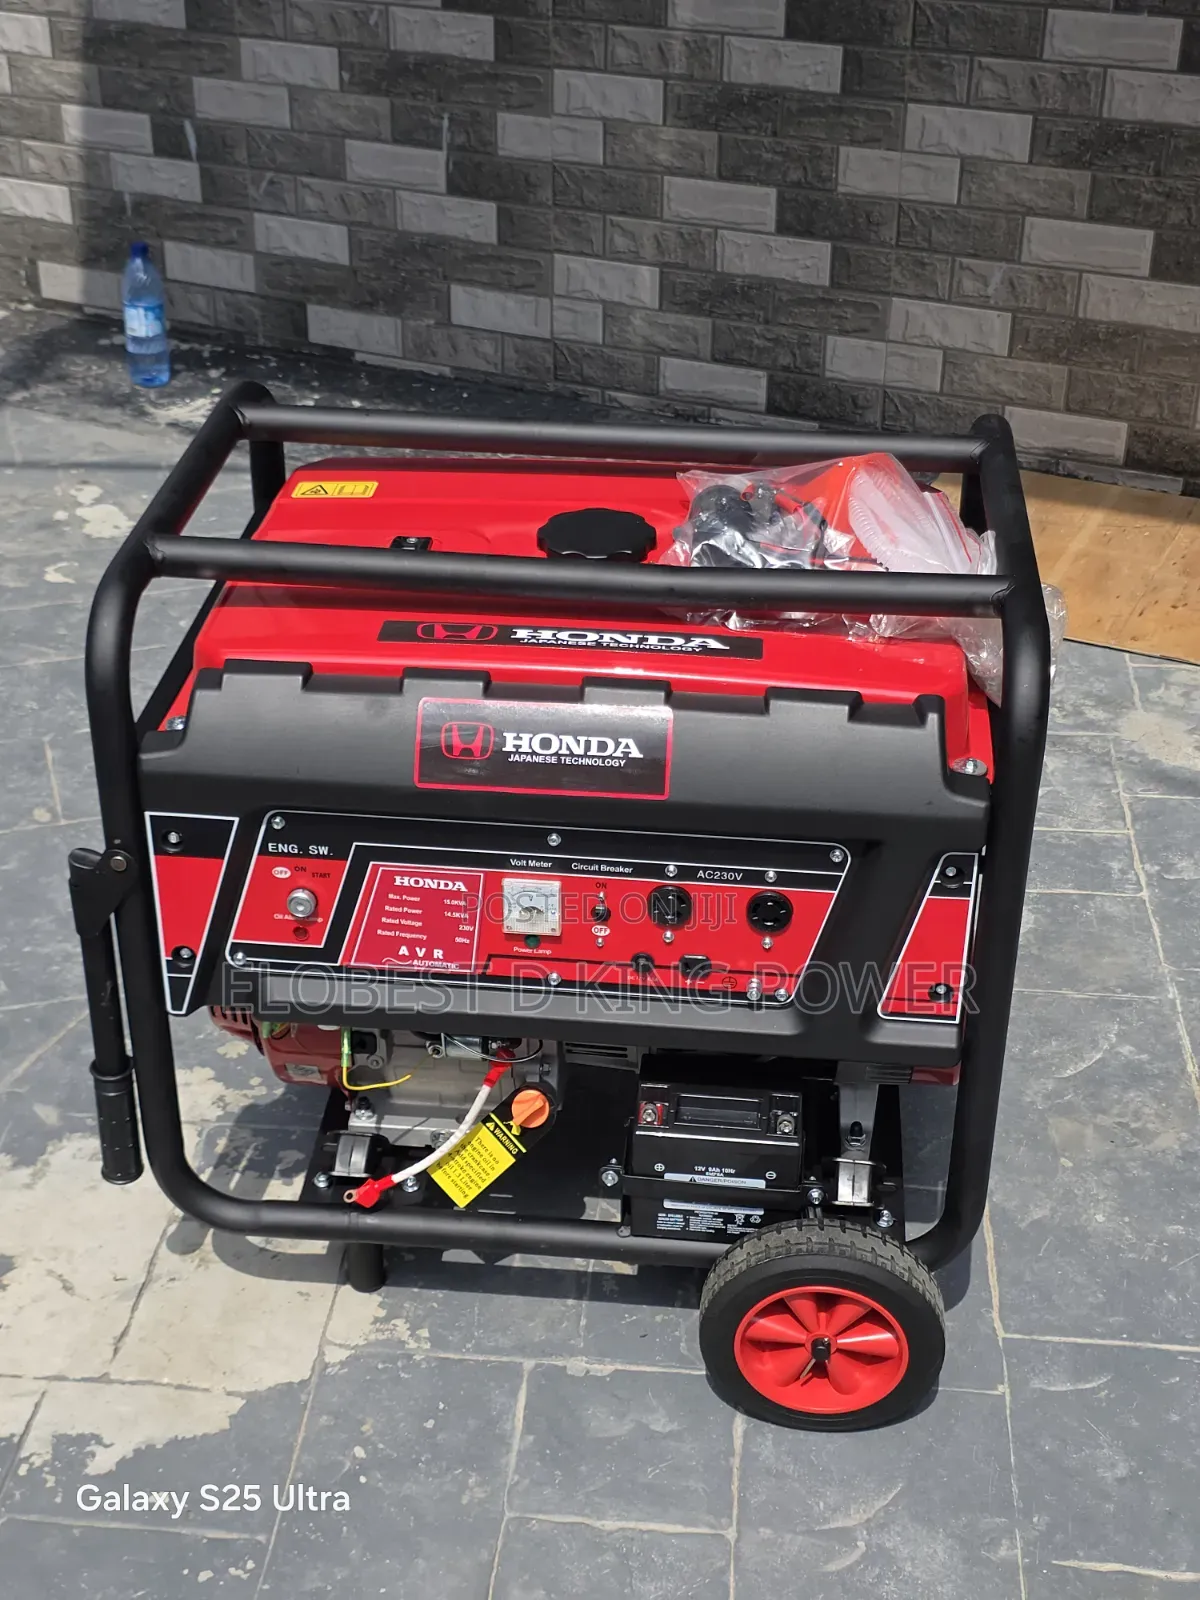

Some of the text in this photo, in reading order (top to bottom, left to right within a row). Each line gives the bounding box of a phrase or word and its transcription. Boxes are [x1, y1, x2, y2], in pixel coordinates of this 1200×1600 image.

[511, 628, 729, 650] HONDA
[520, 638, 702, 652] JAPANESE TECHNOLOGY
[502, 732, 643, 758] HONDA
[508, 753, 626, 768] JAPANESE TECHNOLOGY
[268, 842, 333, 855] ENG. SW.
[510, 858, 552, 868] Volt Meter
[571, 862, 633, 874] Circuit Breaker
[697, 870, 743, 881] AC230V
[394, 875, 468, 892] HONDA
[385, 905, 402, 913] Rated
[400, 919, 422, 927] Voltage
[459, 924, 474, 932] 230V
[593, 926, 608, 934] OFF
[377, 929, 427, 940] Rated Frequency
[412, 959, 460, 970] AUTOMATIC
[474, 1137, 490, 1153] There
[493, 1127, 519, 1155] WARNING
[466, 1141, 484, 1159] engine
[436, 1162, 452, 1179] before
[454, 1149, 486, 1184] Add specified
[459, 1176, 473, 1191] Liter
[464, 1172, 482, 1191] engine
